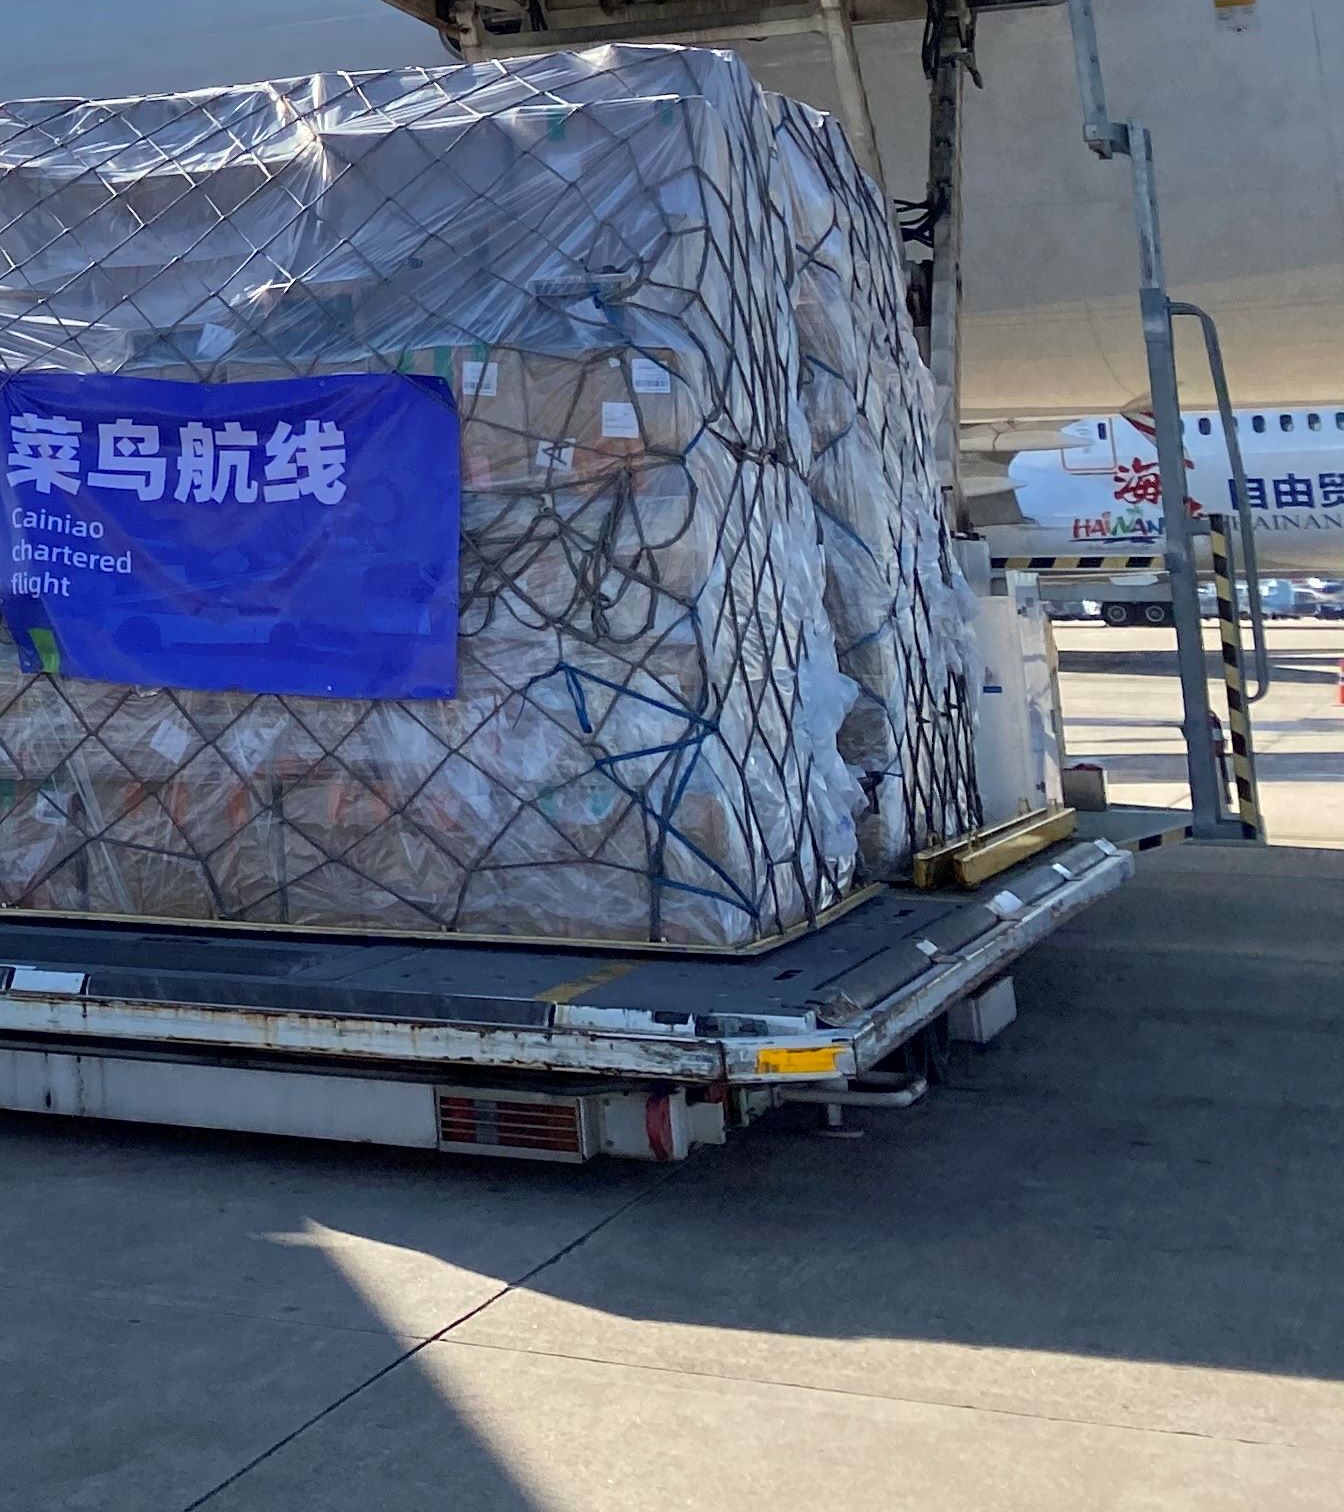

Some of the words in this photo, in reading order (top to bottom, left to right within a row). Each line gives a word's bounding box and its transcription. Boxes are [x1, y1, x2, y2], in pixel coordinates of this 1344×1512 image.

[6, 412, 347, 505] 菜鸟航线
[12, 507, 104, 539] Cainiao
[1073, 511, 1165, 538] HAINAN
[12, 538, 132, 574] chartered
[11, 571, 71, 598] flight
